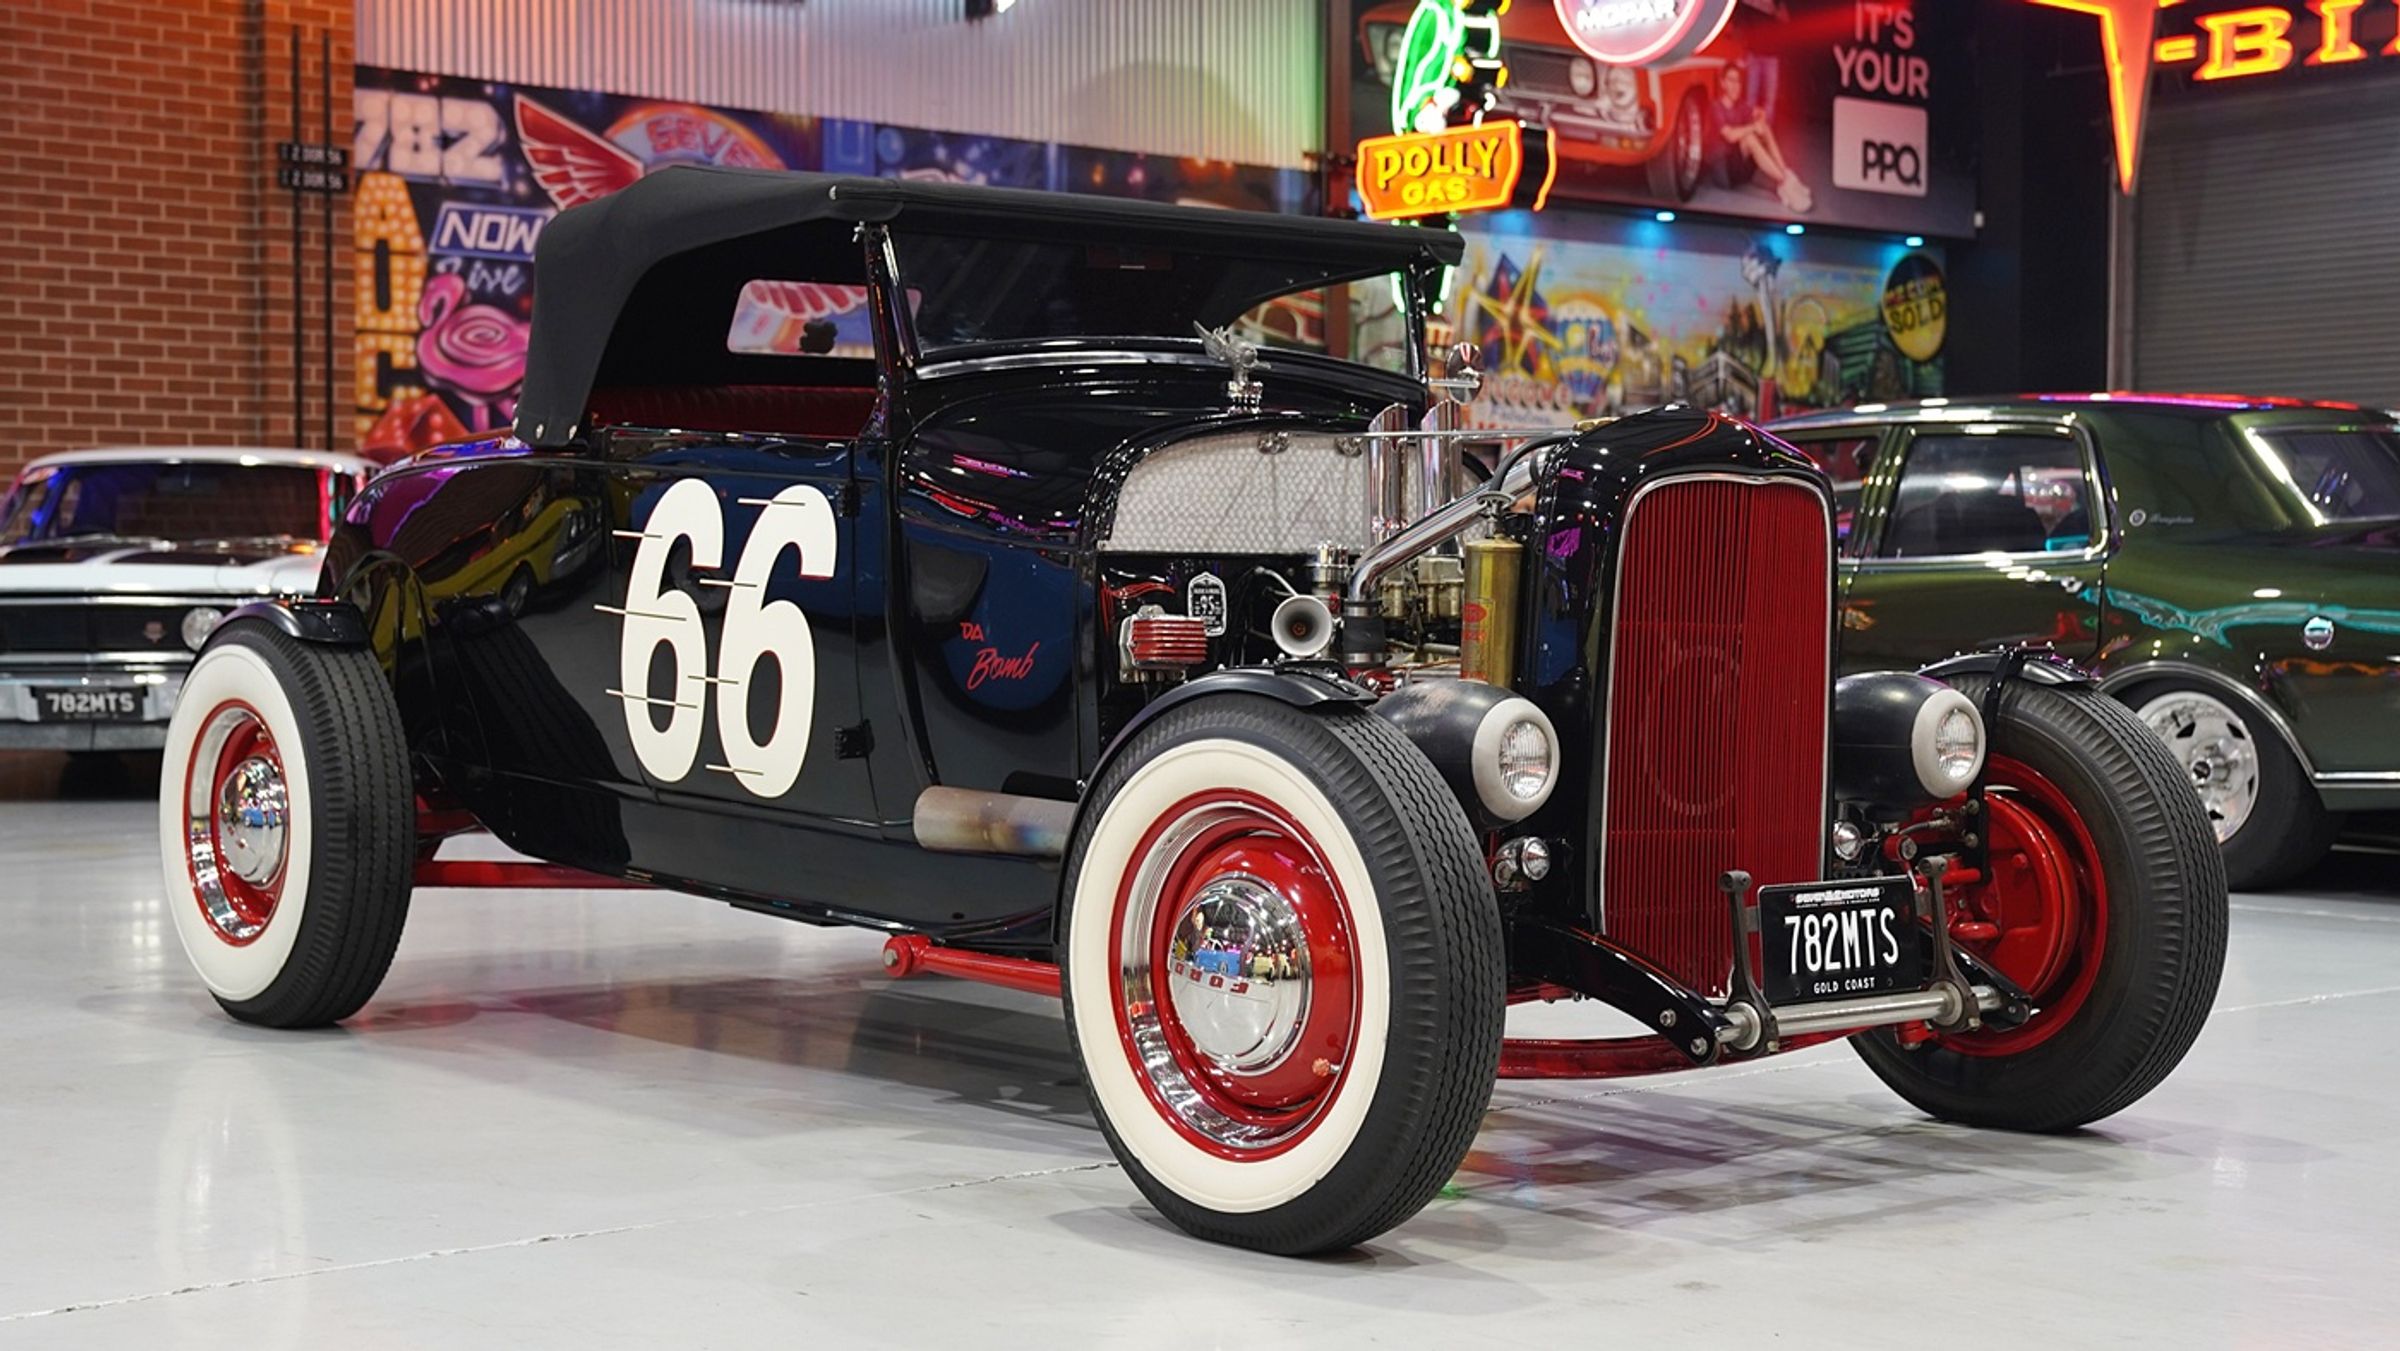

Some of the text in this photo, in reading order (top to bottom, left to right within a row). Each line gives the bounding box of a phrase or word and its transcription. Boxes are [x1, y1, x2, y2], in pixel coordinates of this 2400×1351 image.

[1854, 1, 1915, 50] IT'S
[1832, 45, 1930, 99] YOUR
[354, 88, 505, 182] 782
[1374, 137, 1500, 190] POLLY
[1862, 138, 1922, 187] PPQ
[1401, 176, 1468, 206] GAS
[439, 211, 543, 254] NOW
[1889, 299, 1943, 334] SOLD
[620, 477, 838, 798] 66
[960, 622, 984, 641] DA
[967, 641, 1040, 690] Bomb
[45, 692, 135, 712] 782MTS
[1784, 907, 1899, 975] 782MTS
[1174, 961, 1250, 995] FORD
[1814, 977, 1876, 994] GOLD COAST
